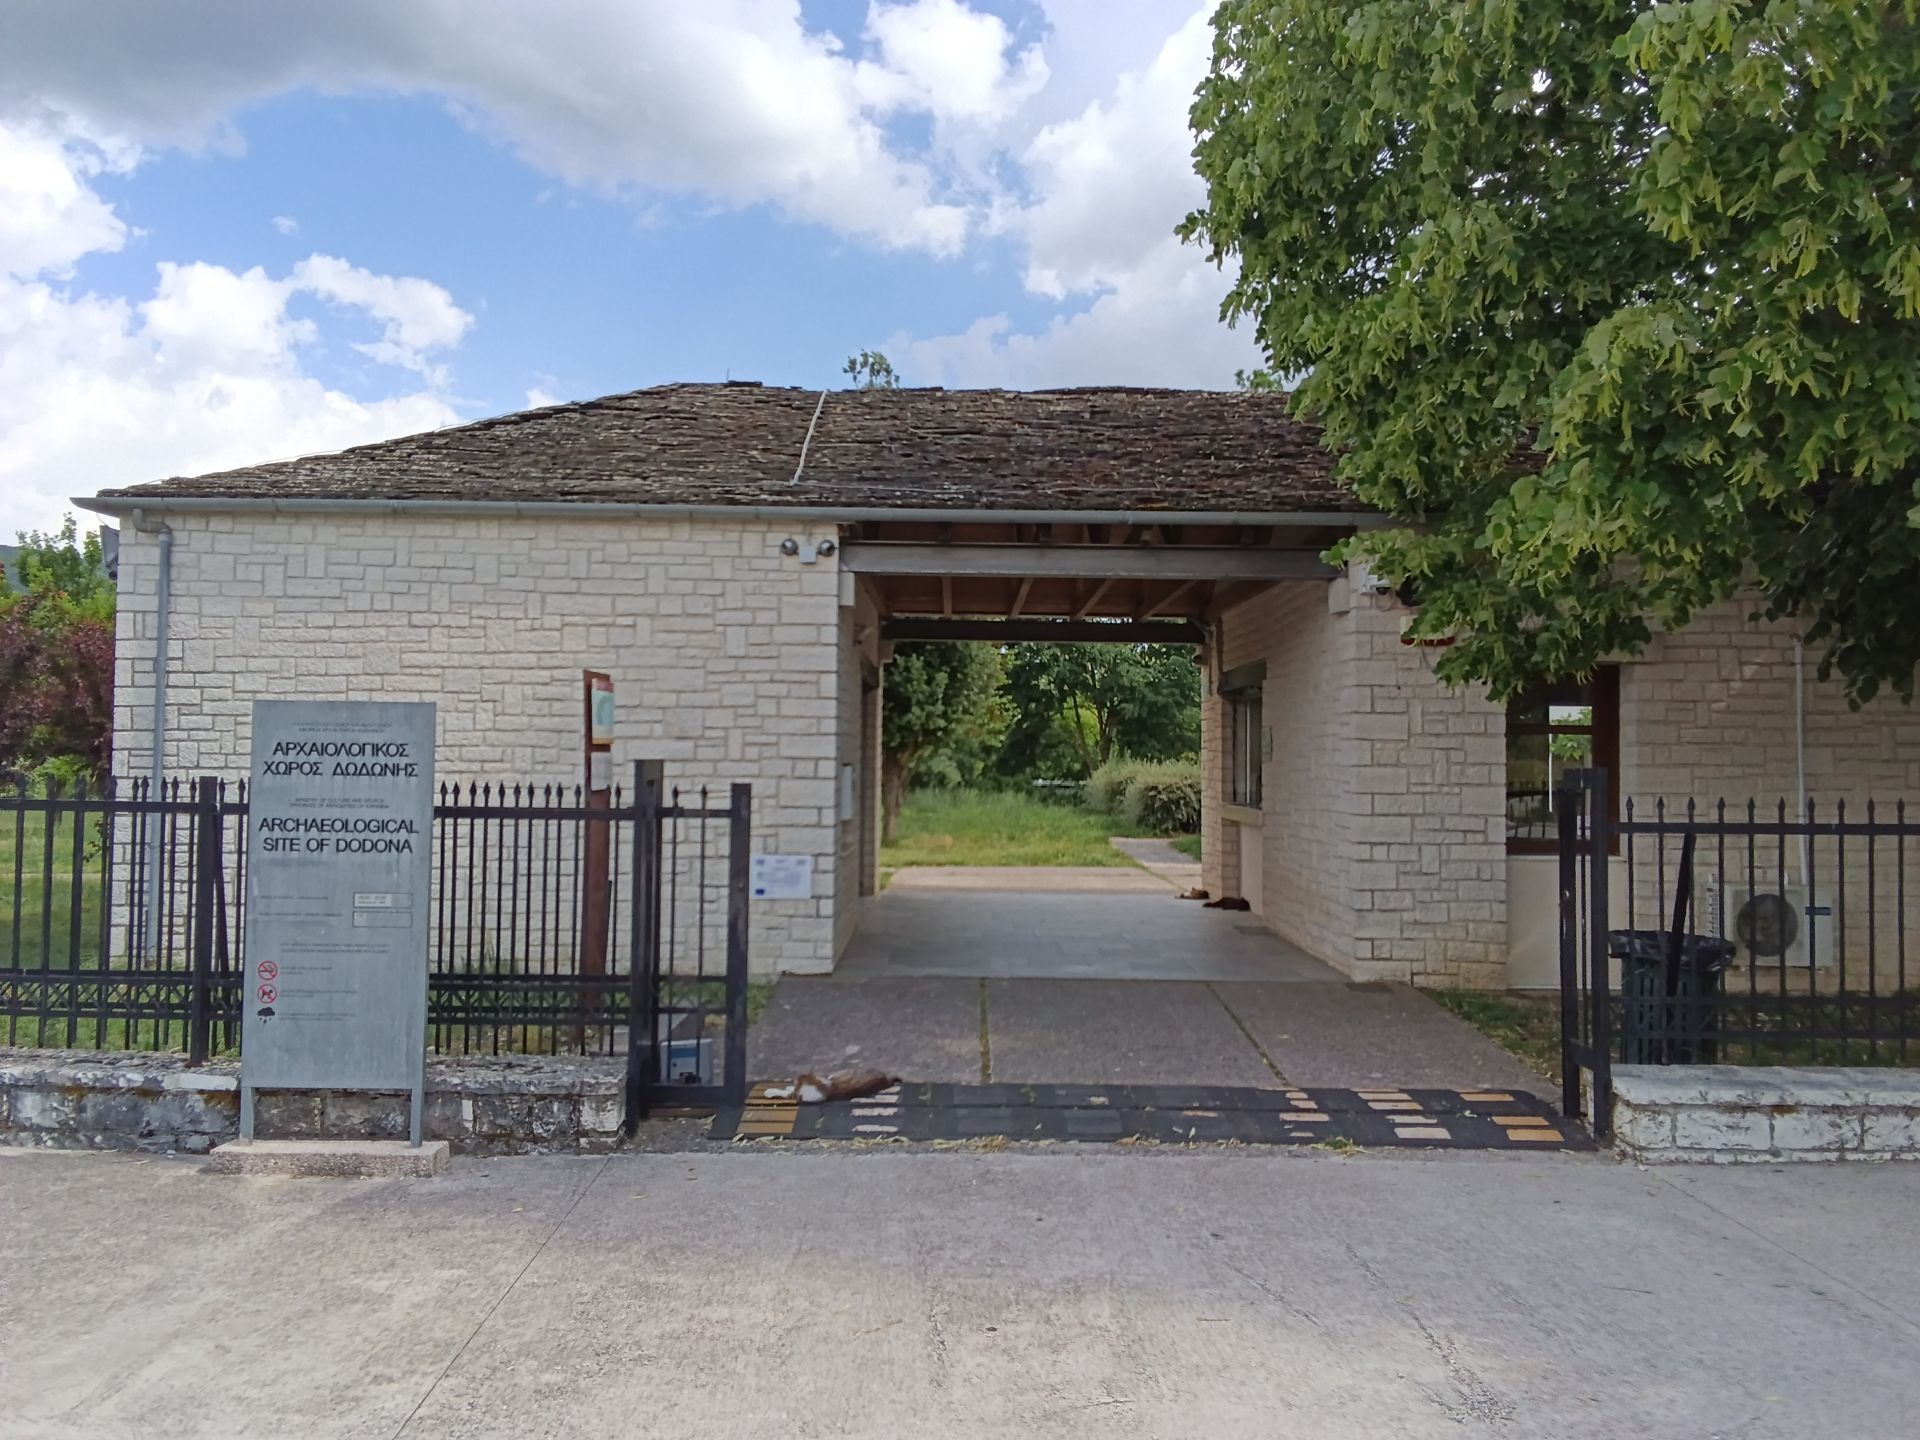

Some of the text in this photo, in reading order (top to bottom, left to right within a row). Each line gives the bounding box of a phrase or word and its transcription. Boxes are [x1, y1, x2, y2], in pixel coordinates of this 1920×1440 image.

[272, 741, 410, 758] ΑΡΧΑΙΟΛΟΓΙΚΟΣ
[262, 761, 419, 777] ΧΩΡΟΣ ΔΩΔΩΝΗΣ
[258, 817, 419, 834] ARCHAEOLOGICAL
[263, 837, 413, 854] SITE OF DODONA
